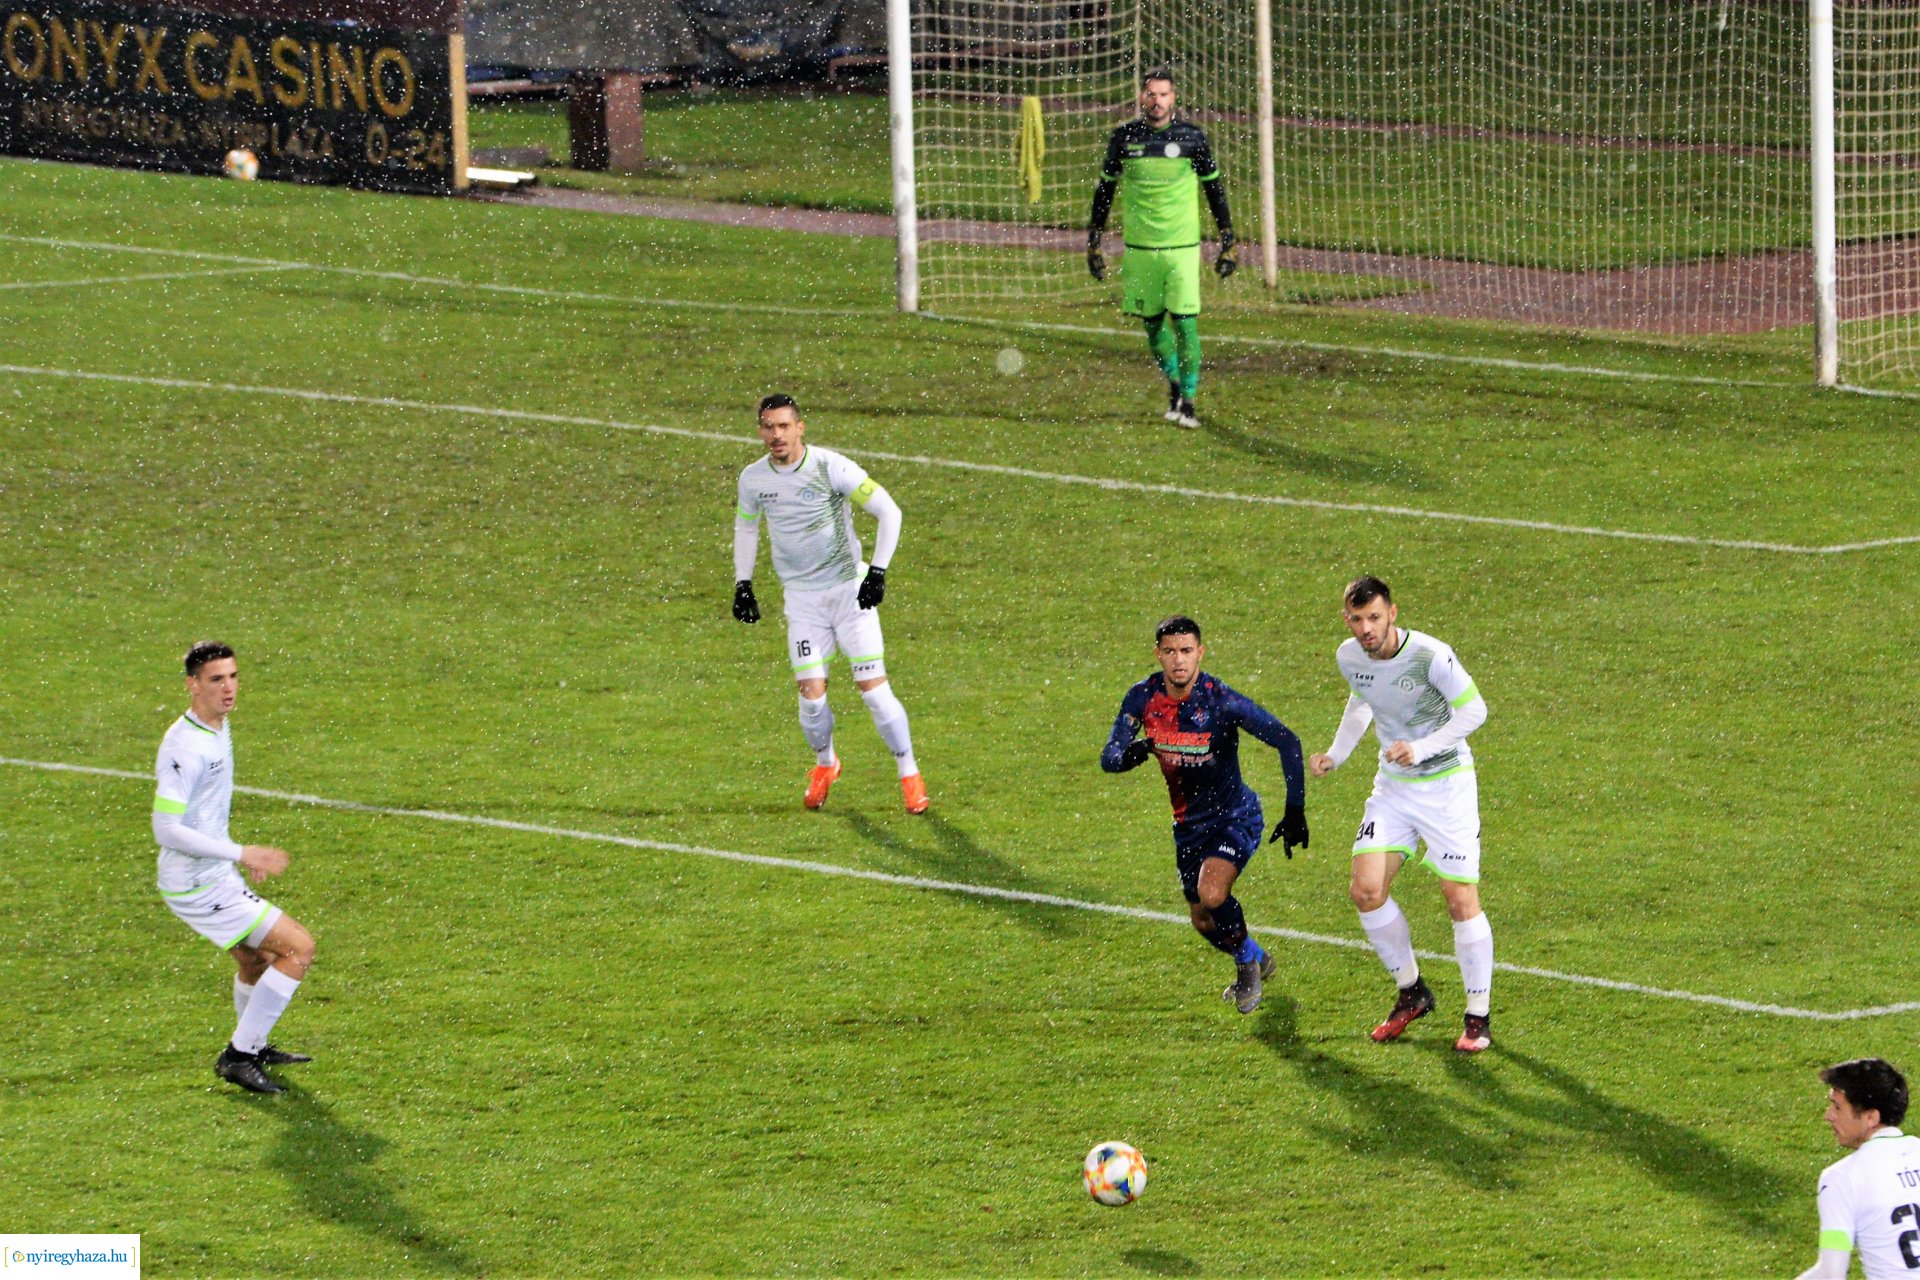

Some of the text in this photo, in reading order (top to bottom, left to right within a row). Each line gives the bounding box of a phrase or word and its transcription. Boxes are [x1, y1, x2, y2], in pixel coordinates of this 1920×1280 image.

[4, 11, 416, 117] ONYX CASINO
[858, 482, 873, 496] C
[796, 639, 812, 658] 16
